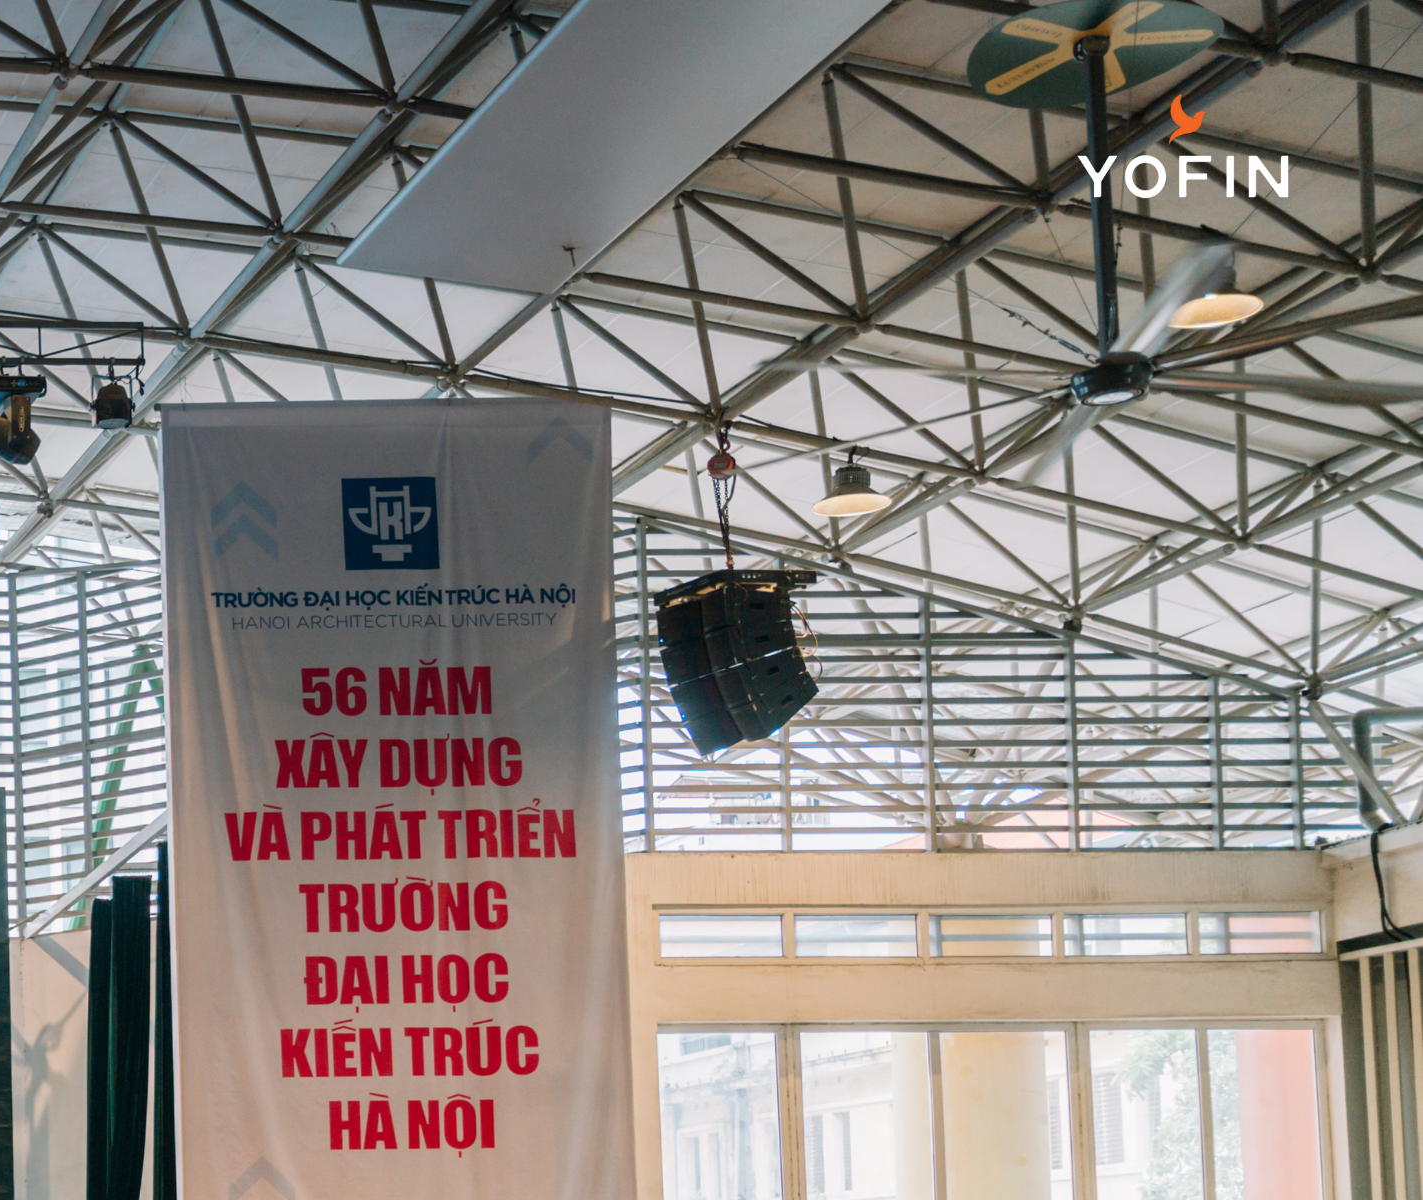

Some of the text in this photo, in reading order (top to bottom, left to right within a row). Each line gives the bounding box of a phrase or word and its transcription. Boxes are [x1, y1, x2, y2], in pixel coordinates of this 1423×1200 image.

[211, 583, 576, 611] TRƯỜNG ĐẠI HỌC KIẾN TRÚC HÀ NỘI
[231, 612, 557, 631] HANOI ARCHITECTURAL UNIVERSITY
[300, 659, 492, 717] 56 NĂM
[274, 731, 522, 796] XÂY DỰNG
[224, 797, 577, 862] VÀ PHÁT TRIỂN
[299, 877, 509, 933] TRƯỜNG
[304, 953, 509, 1013] ĐẠI HỌC
[280, 1018, 540, 1078] KIẾN TRÚC
[329, 1092, 495, 1158] HÀ NỘI
